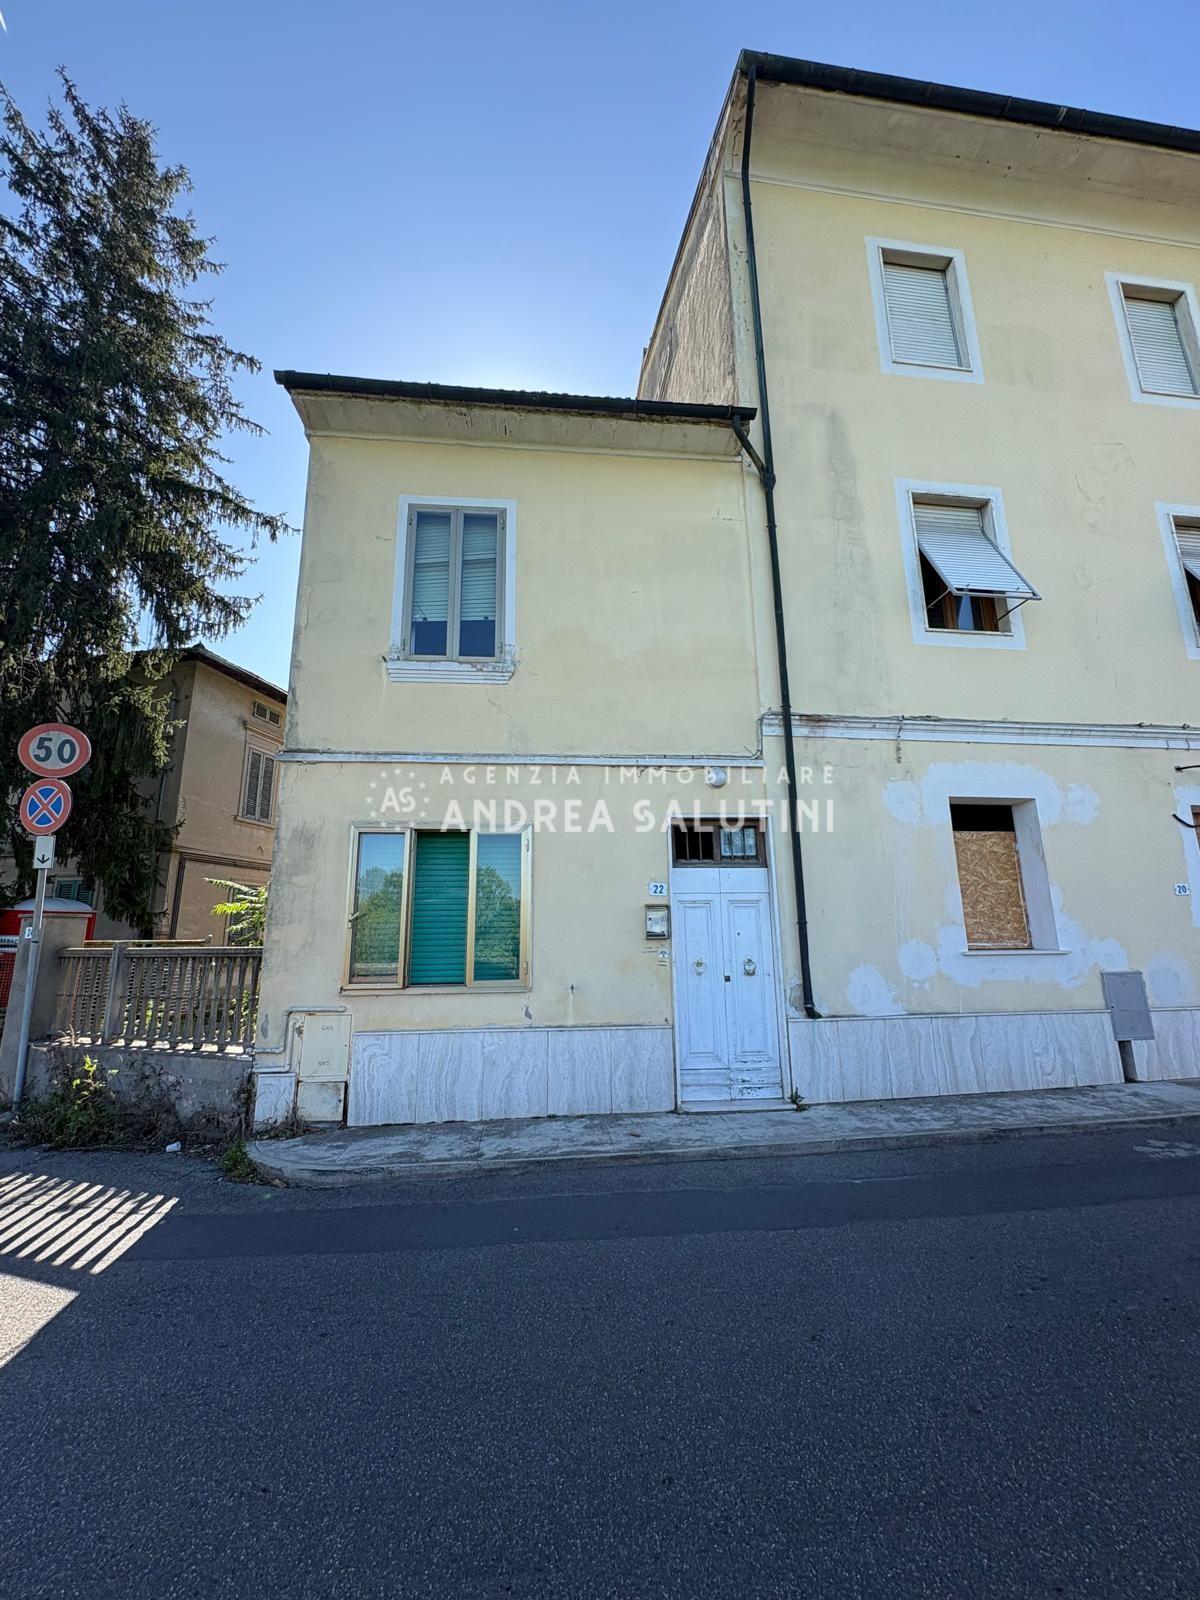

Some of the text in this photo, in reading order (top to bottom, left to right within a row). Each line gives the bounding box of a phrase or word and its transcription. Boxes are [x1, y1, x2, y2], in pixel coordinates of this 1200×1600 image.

[33, 736, 77, 764] 50
[653, 884, 664, 894] 22
[1177, 884, 1187, 894] 20
